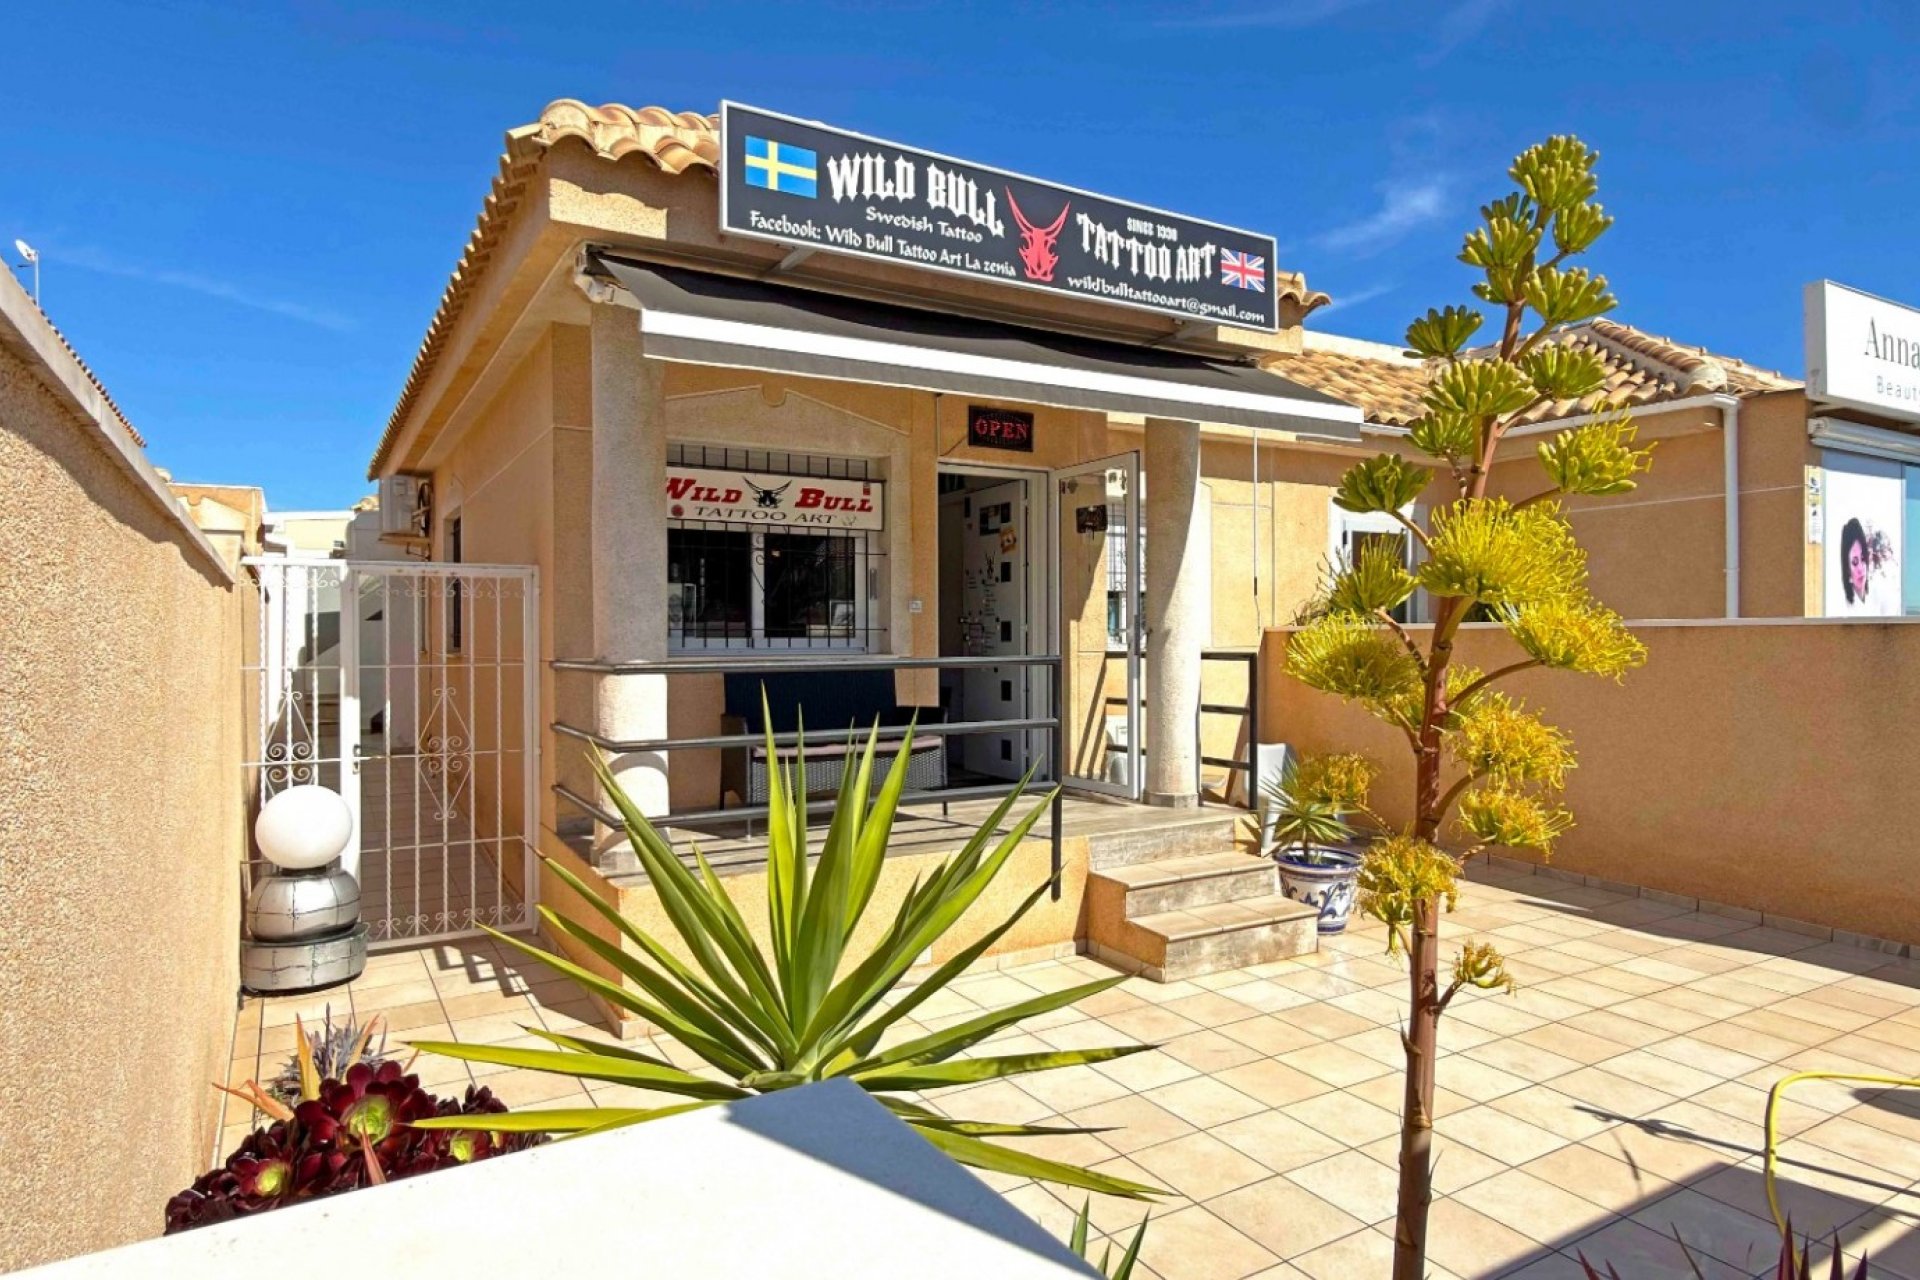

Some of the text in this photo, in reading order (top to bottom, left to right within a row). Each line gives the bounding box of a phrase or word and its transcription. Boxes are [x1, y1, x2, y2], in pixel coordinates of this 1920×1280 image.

[827, 152, 1005, 238] WILD BULL
[750, 210, 821, 239] Facebook:
[826, 225, 863, 248] Wild
[866, 234, 893, 254] Bull
[897, 239, 937, 263] Tattoo
[939, 250, 963, 267] Art
[965, 253, 981, 271] La
[866, 206, 983, 243] Swedish Tattoo
[1126, 216, 1154, 236] SINCE
[1076, 213, 1216, 283] TATTOO ART
[1864, 316, 1920, 370] Anna
[1876, 375, 1920, 402] Beaut
[975, 418, 1028, 440] OPEN
[694, 505, 837, 524] TATTOO ART
[794, 487, 874, 512] BULL
